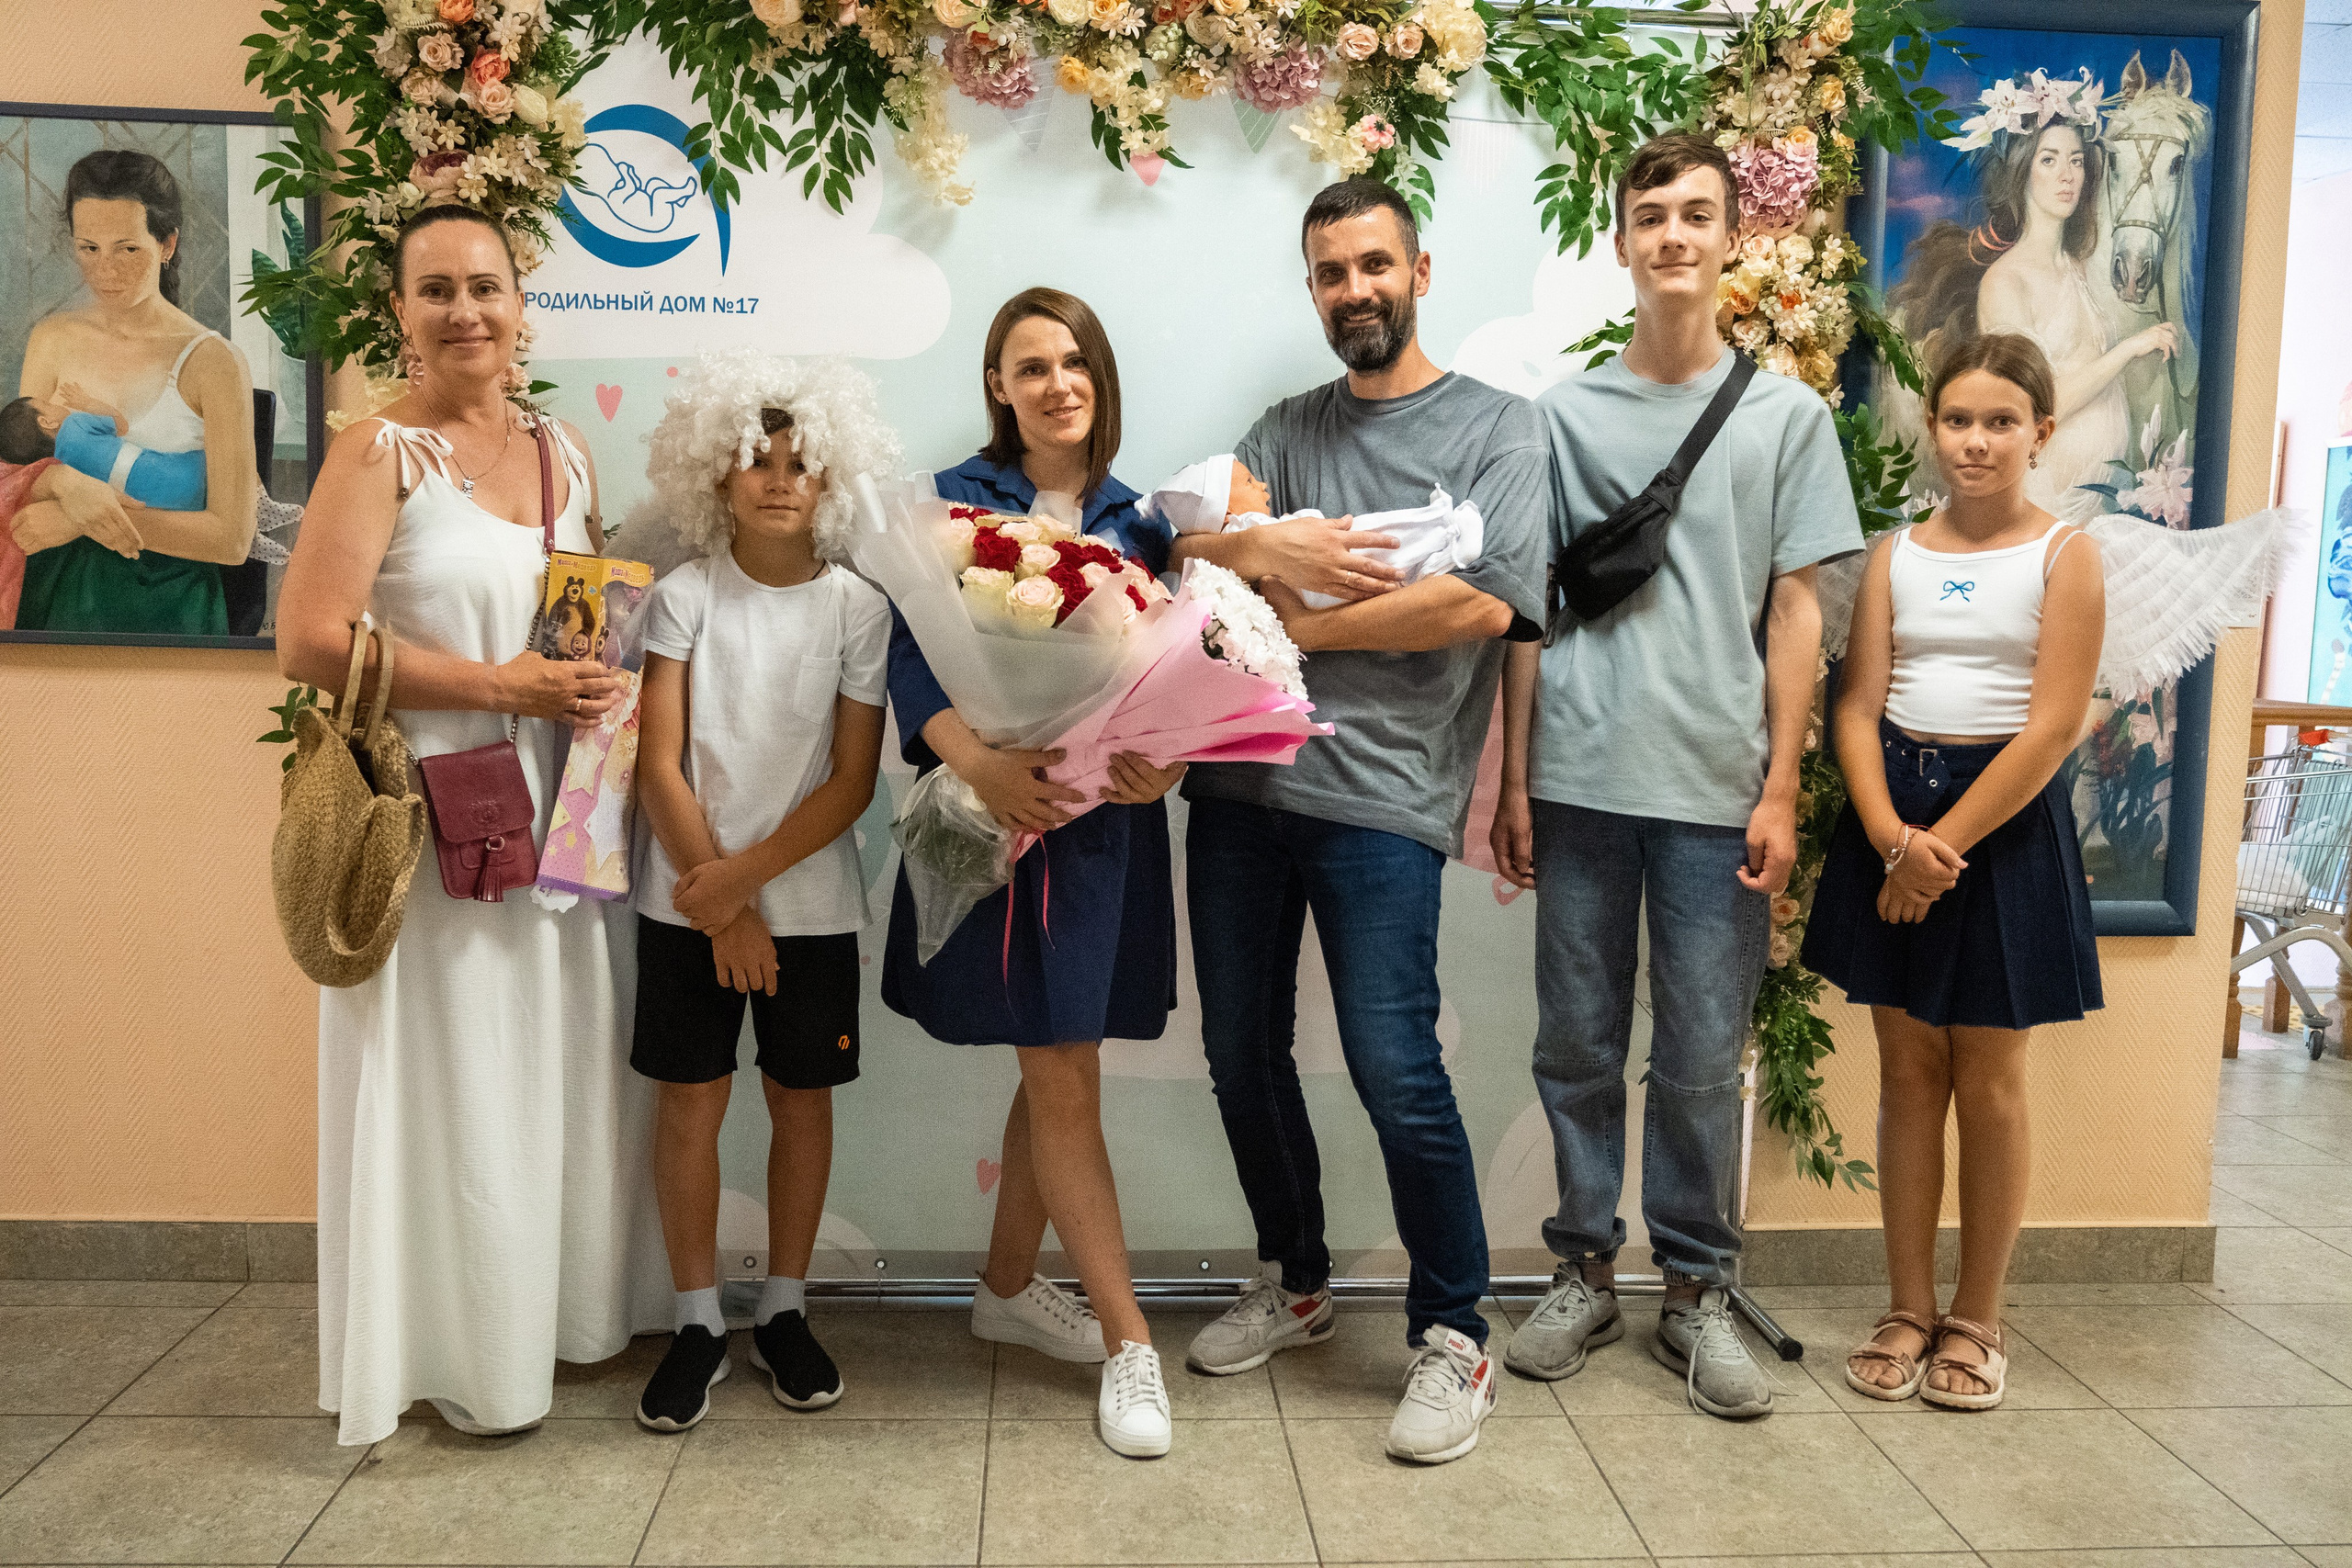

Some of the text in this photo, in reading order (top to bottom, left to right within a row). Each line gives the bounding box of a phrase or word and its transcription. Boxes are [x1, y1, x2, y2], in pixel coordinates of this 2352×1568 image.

[524, 290, 760, 315] РОДИЛЬНЫЙ ДОМ №17
